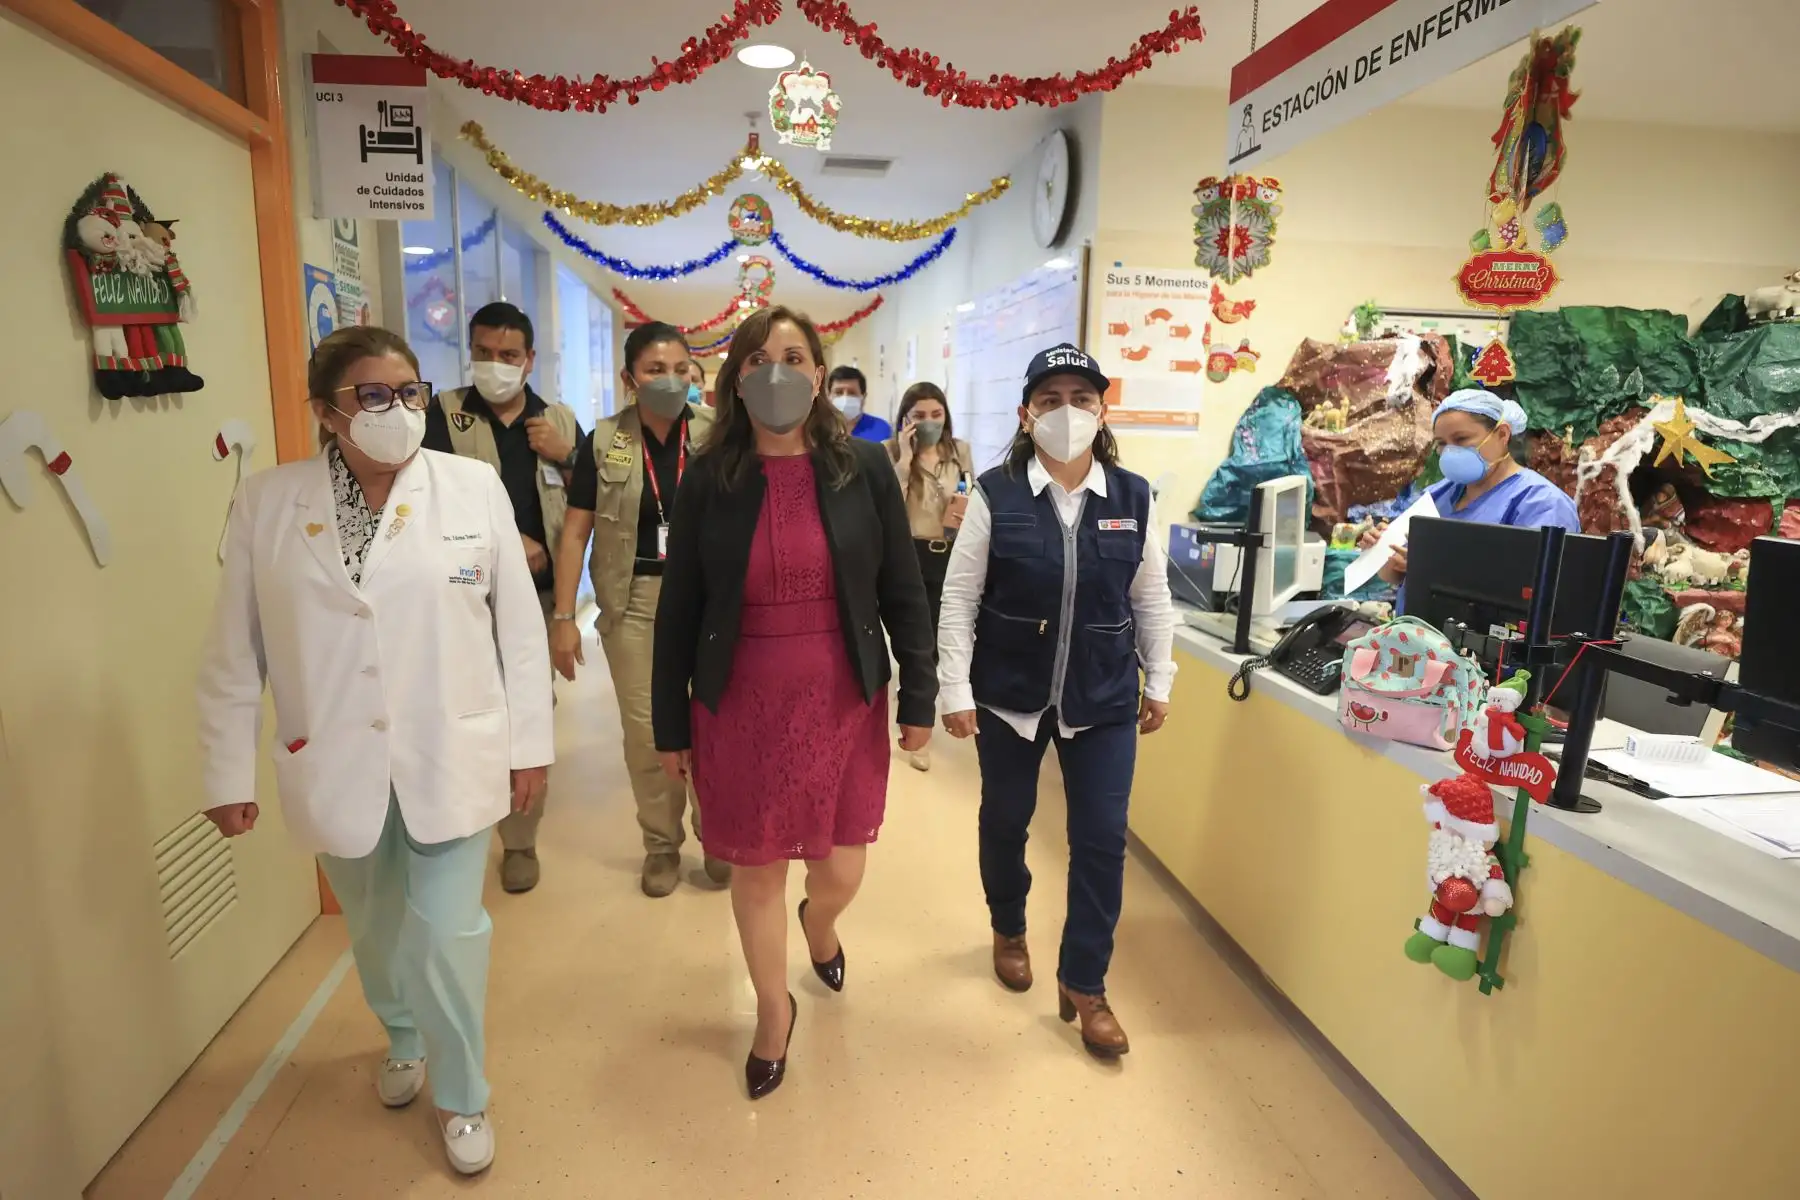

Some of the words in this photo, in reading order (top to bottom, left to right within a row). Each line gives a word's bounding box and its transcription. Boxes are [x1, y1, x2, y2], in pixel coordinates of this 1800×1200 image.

[1262, 65, 1348, 133] ESTACIÓN
[1354, 45, 1383, 84] DE
[1389, 0, 1511, 65] ENFERM
[316, 92, 335, 102] UCI
[337, 93, 343, 102] 3
[385, 172, 424, 183] Unidad
[357, 186, 370, 195] de
[373, 186, 424, 196] Cuidados
[369, 199, 425, 210] Intensivos
[1492, 262, 1540, 271] MERRY
[1106, 273, 1131, 285] Sus
[1135, 275, 1142, 285] 5
[1145, 275, 1209, 288] Momentos
[1468, 267, 1549, 290] Christmas
[92, 273, 124, 305] FELIZ
[1046, 347, 1079, 357] Ministerio
[1047, 353, 1088, 368] Salud
[1463, 745, 1497, 773] FELIZ
[1499, 761, 1544, 785] NAVIDAD
